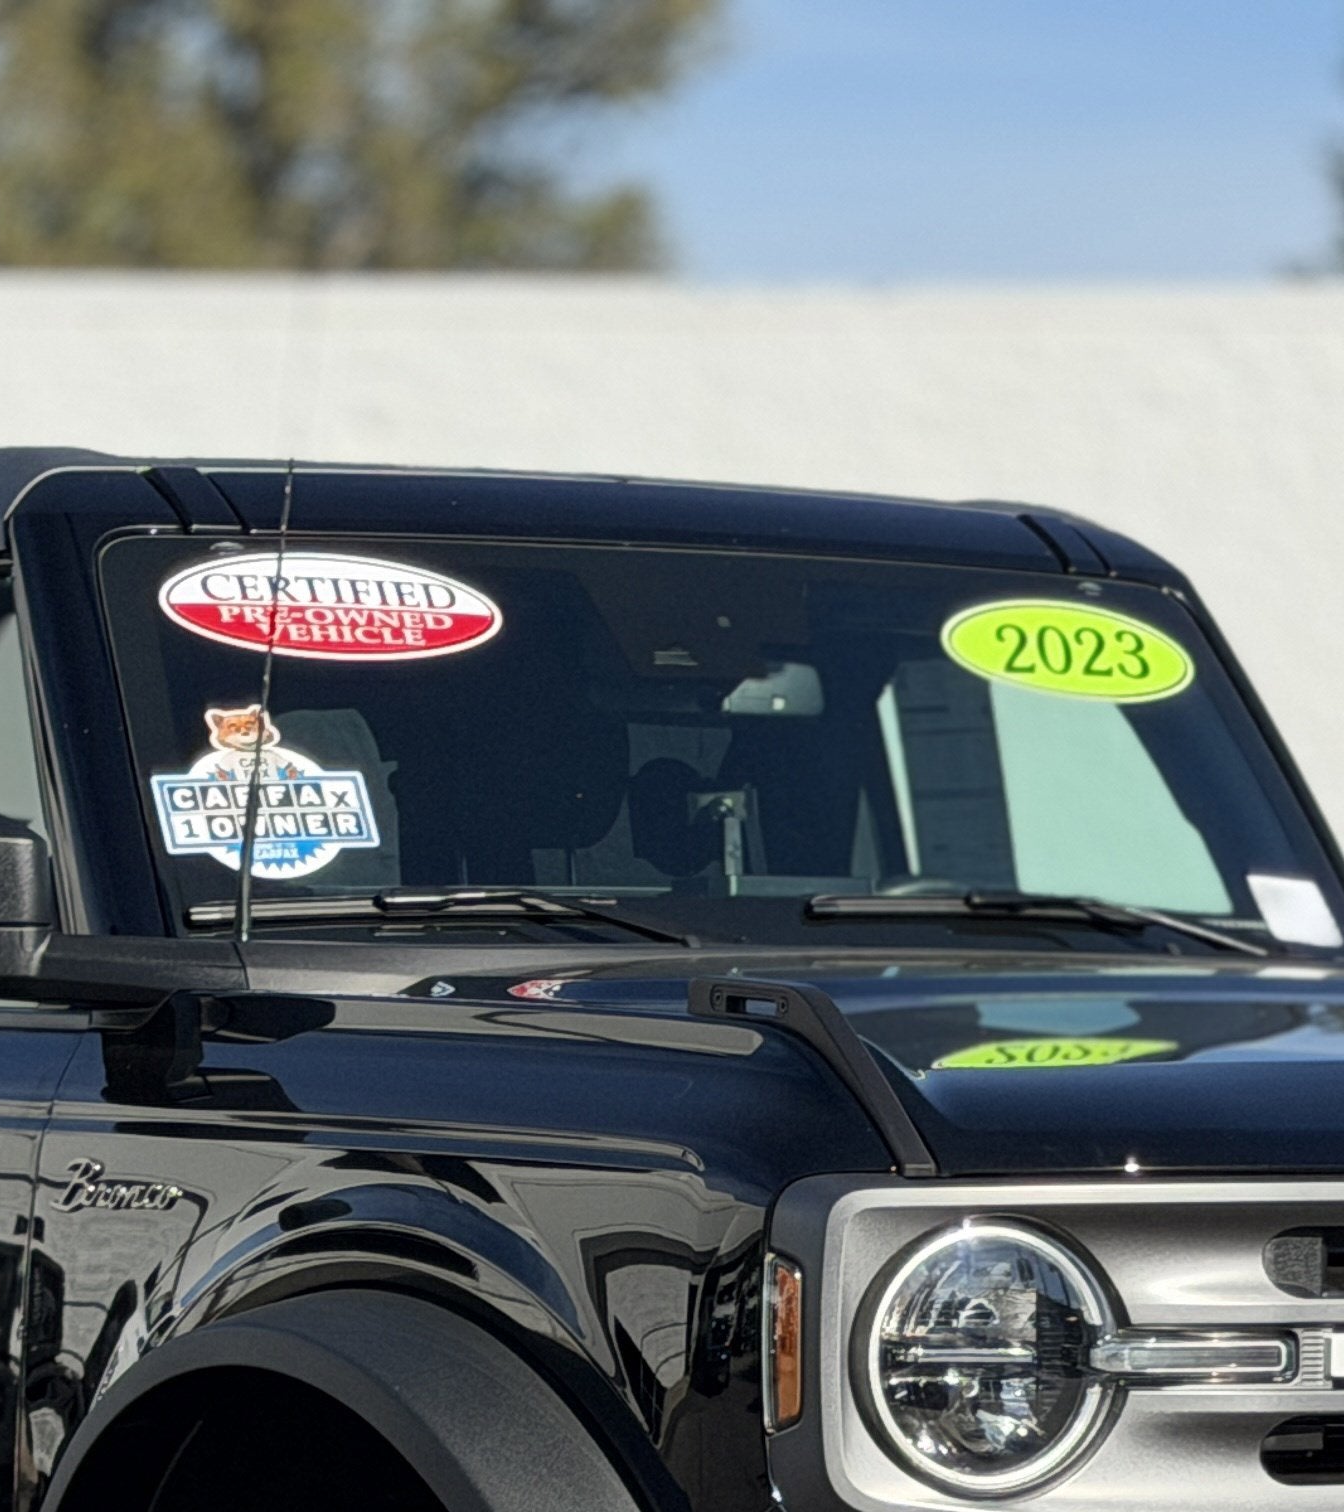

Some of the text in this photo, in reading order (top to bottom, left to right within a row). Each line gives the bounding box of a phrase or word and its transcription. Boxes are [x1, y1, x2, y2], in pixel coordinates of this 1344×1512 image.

[200, 573, 456, 609] CERTIFIED
[216, 605, 454, 631] PRE-OWNED
[255, 623, 427, 647] VEHICLE
[995, 623, 1151, 680] 2023
[51, 1157, 184, 1213] Bronco
